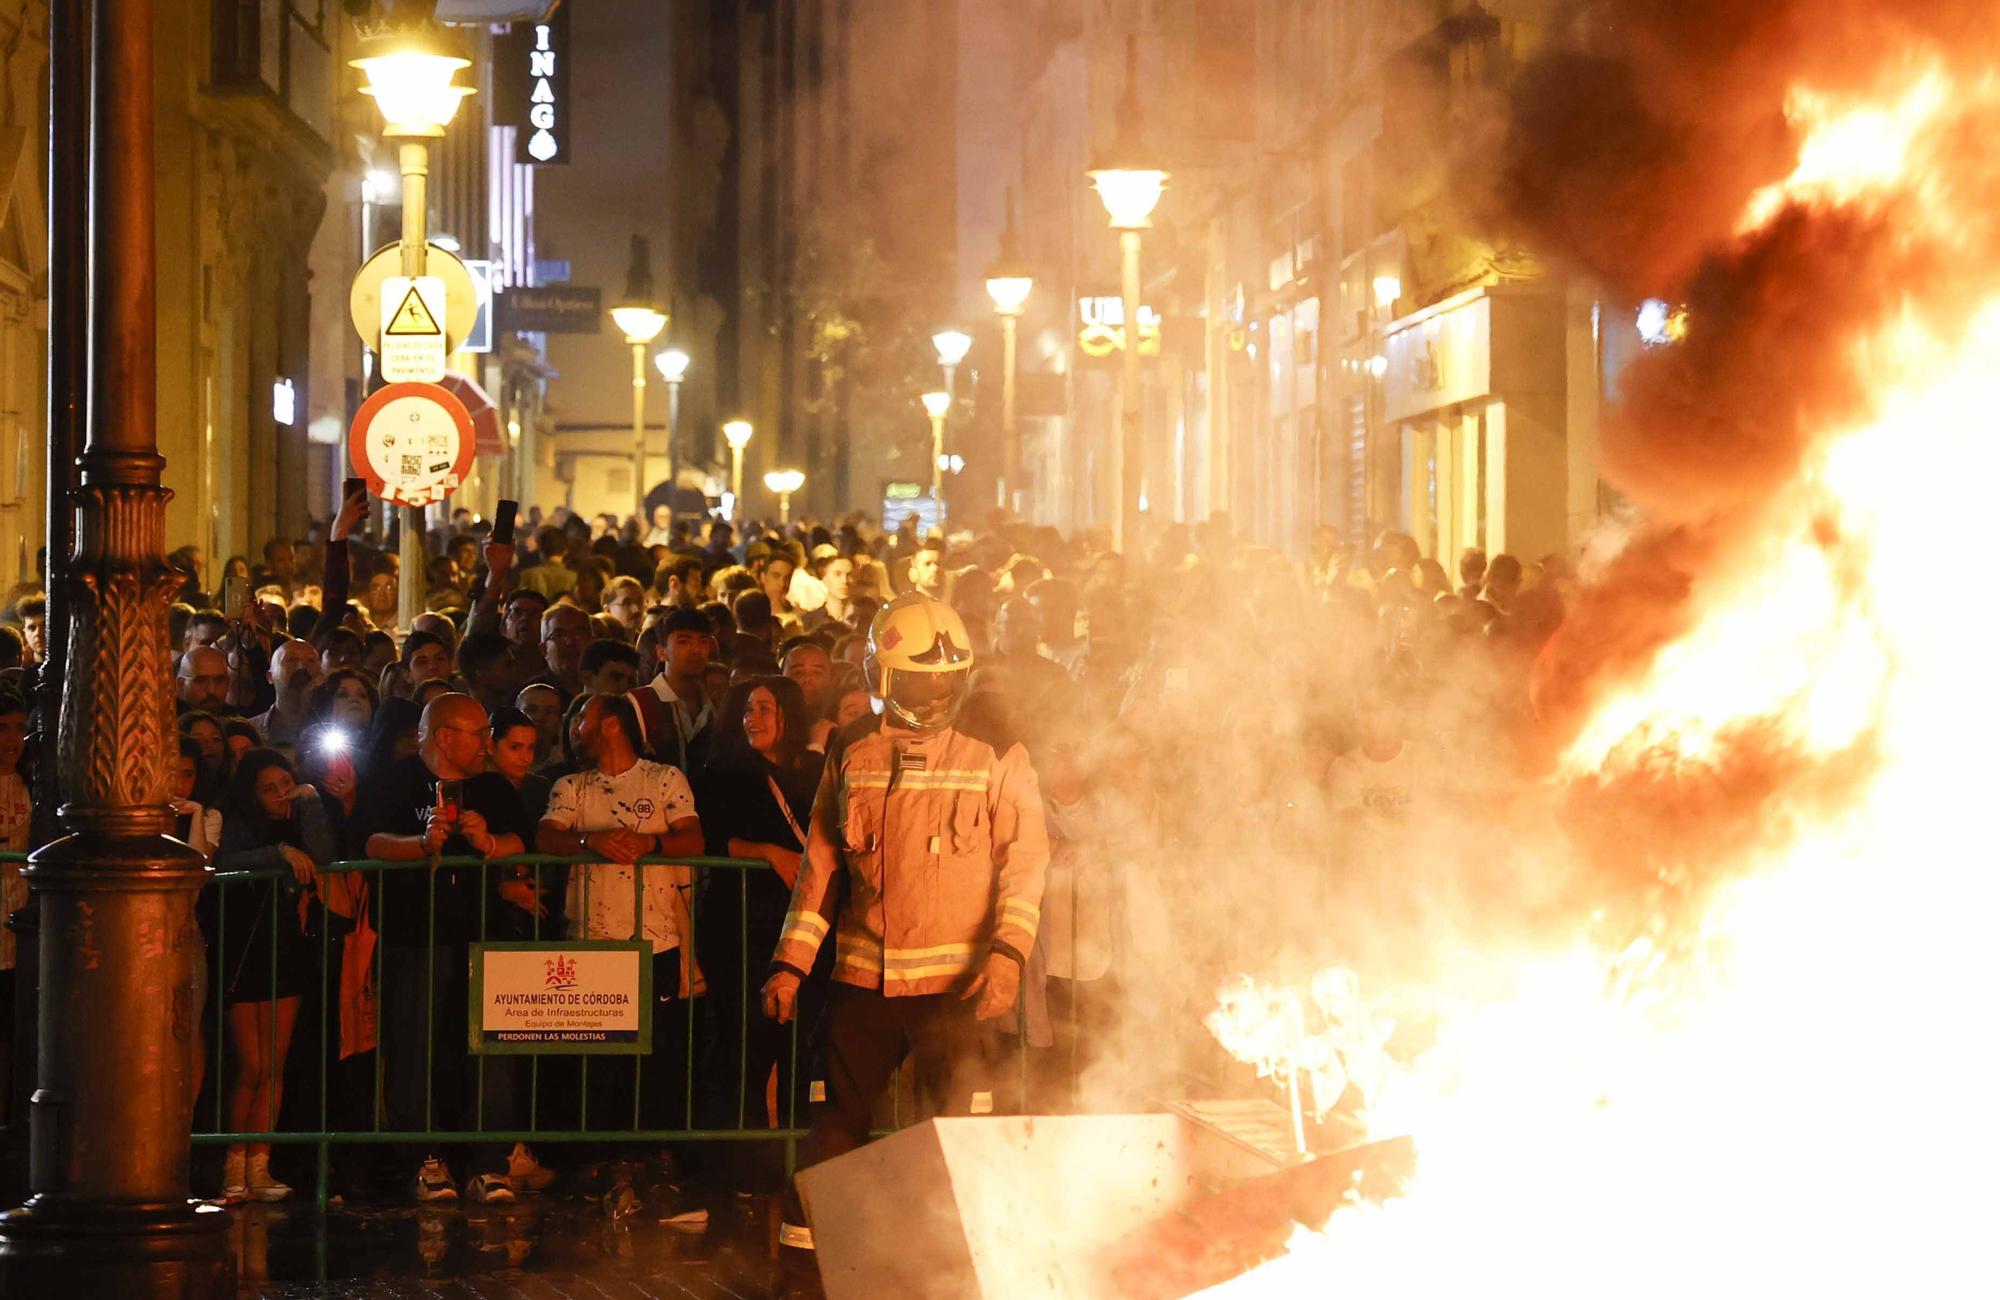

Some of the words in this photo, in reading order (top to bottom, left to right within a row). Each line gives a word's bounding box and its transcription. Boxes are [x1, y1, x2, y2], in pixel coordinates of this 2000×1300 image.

[495, 994, 566, 1005] AYUNTAMIENTO
[568, 994, 580, 1005] DE
[583, 992, 629, 1005] CÓRDOBA
[531, 1008, 544, 1017] de
[547, 1008, 624, 1017] Infraestructuras
[525, 1020, 553, 1028] Equipo
[554, 1020, 565, 1028] de
[567, 1020, 602, 1028] Montajes
[498, 1033, 541, 1041] PERDONEN
[544, 1033, 559, 1041] LAS
[561, 1033, 606, 1041] MOLESTIAS
